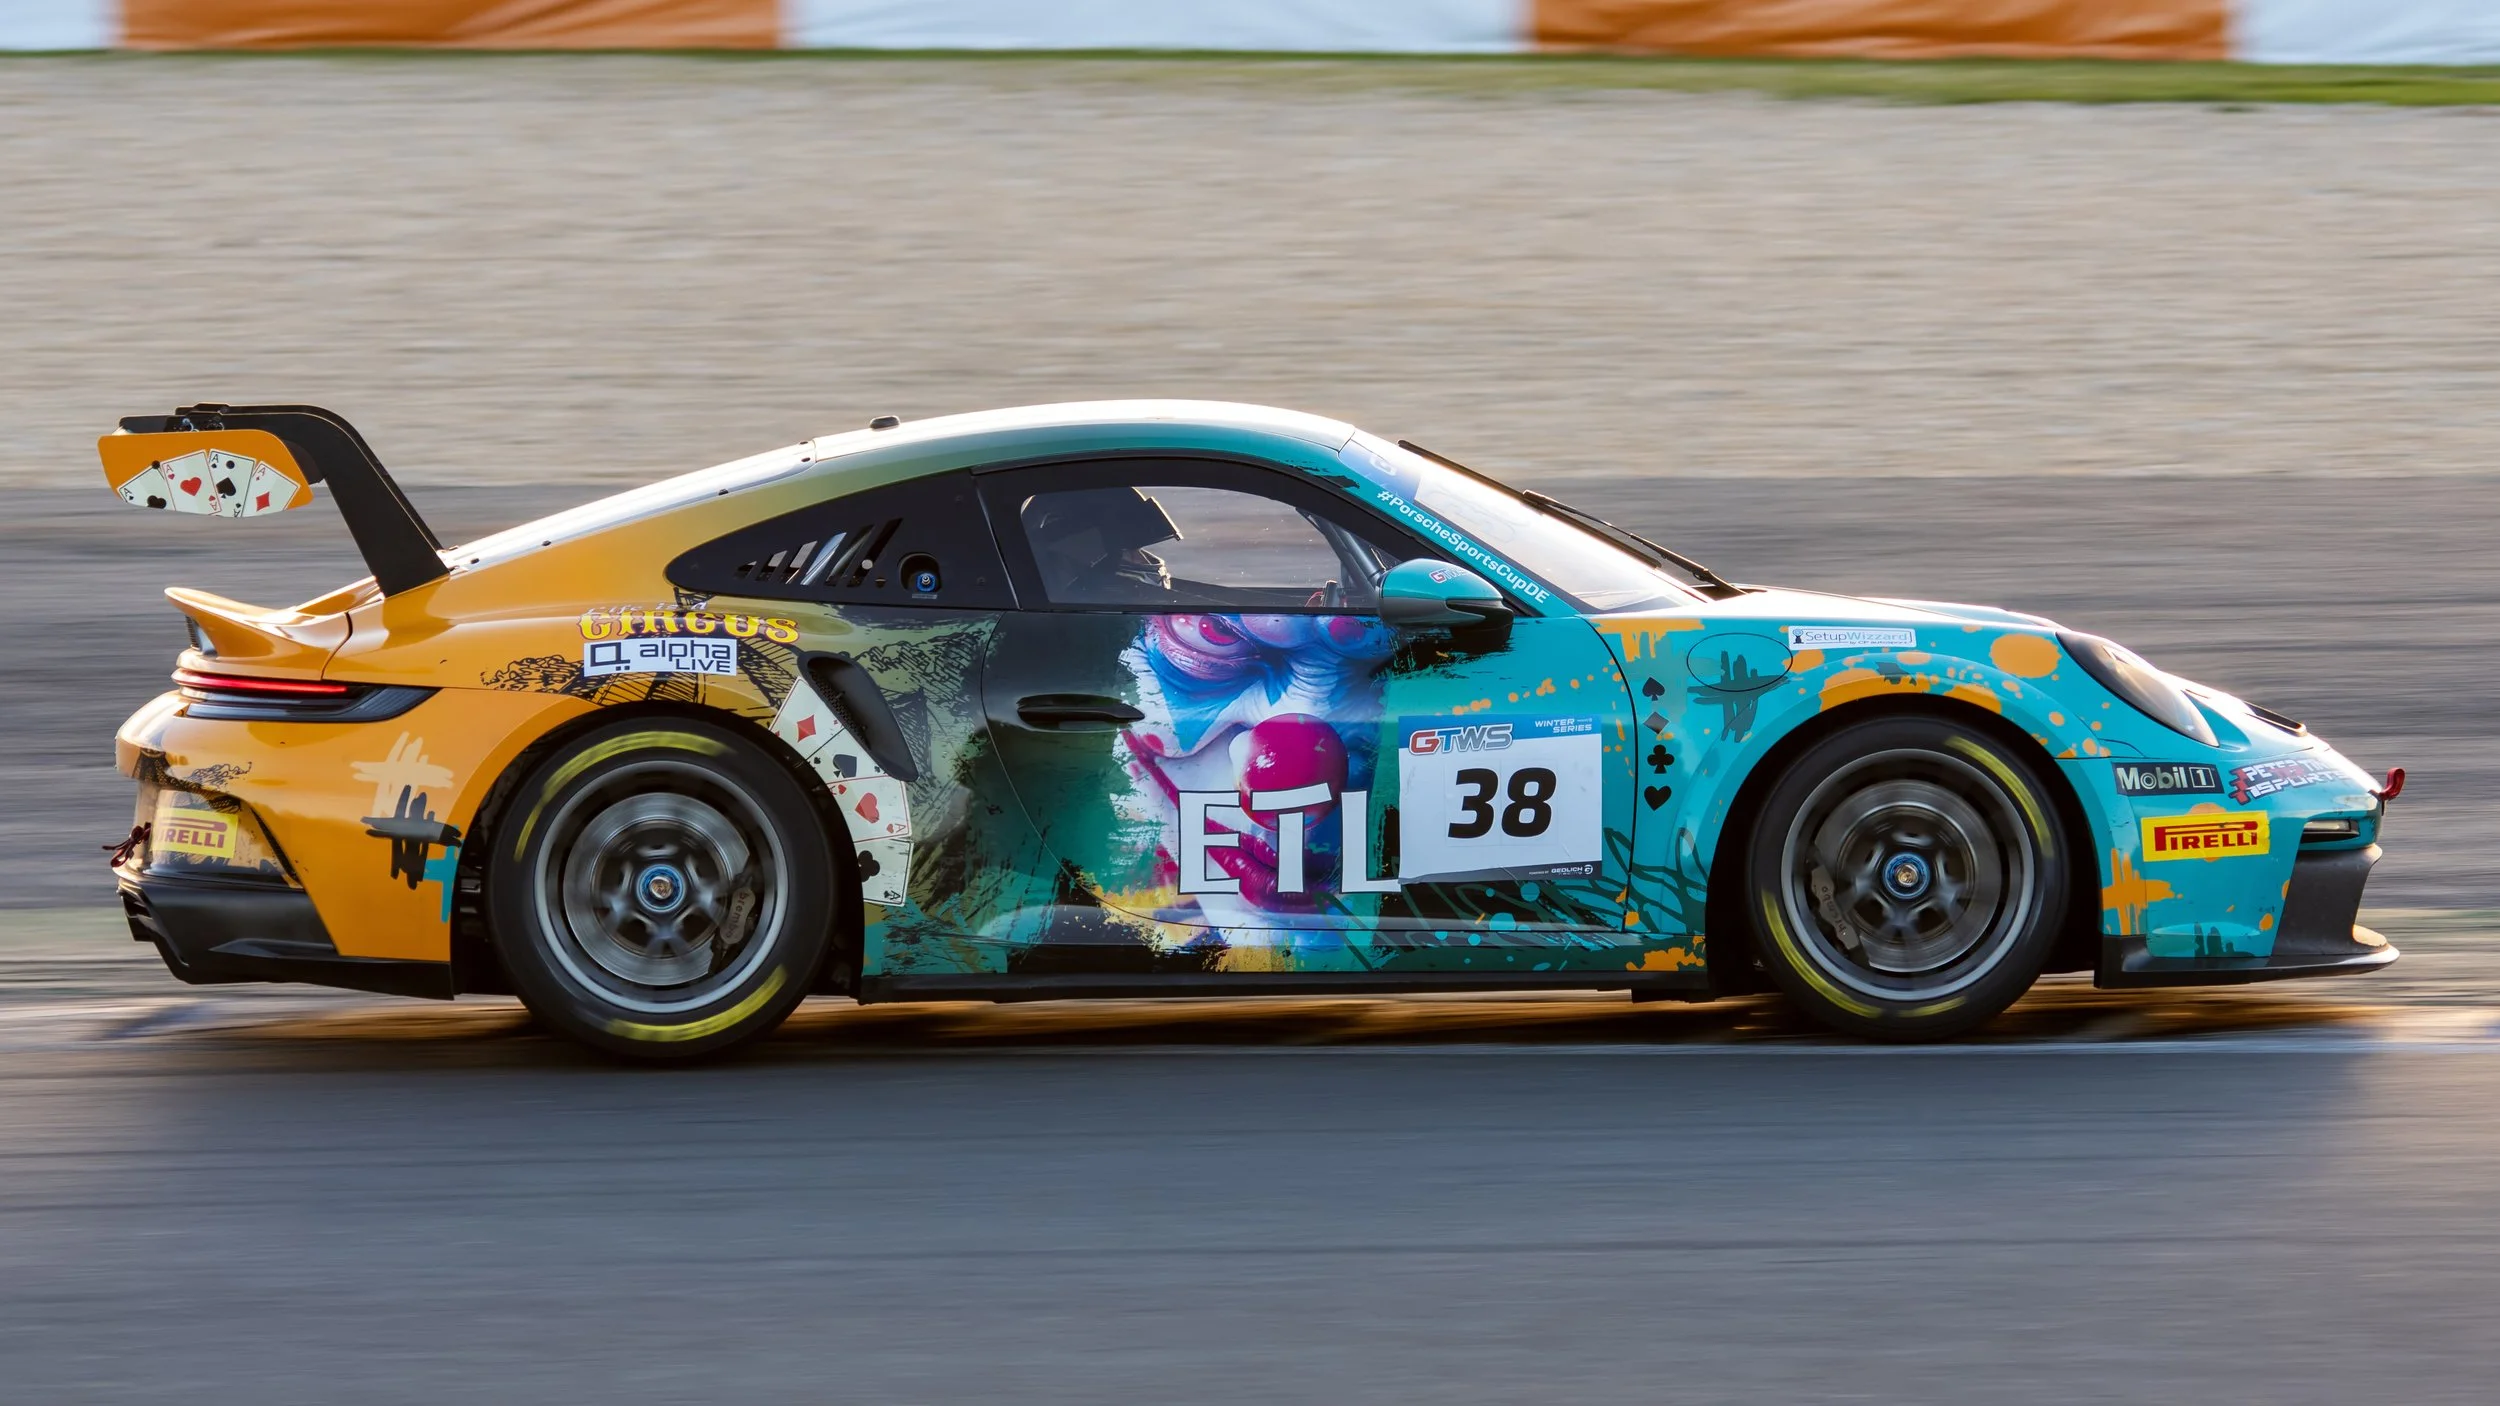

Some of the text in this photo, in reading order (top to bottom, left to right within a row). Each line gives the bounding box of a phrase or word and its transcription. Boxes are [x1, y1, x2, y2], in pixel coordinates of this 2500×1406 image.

[1377, 490, 1550, 604] #PorscheSportsCupDE
[579, 610, 799, 643] CIRCUS
[1805, 631, 1908, 642] SetupWizzard
[639, 640, 730, 661] alpha
[676, 658, 731, 673] LIVE
[1535, 718, 1575, 728] WINTER
[1552, 724, 1592, 734] SERIES
[1409, 724, 1514, 756] GTWS
[2116, 766, 2187, 791] Mobil
[1448, 767, 1557, 839] 38
[1178, 782, 1401, 893] ETL
[2154, 820, 2258, 852] PIRELLI
